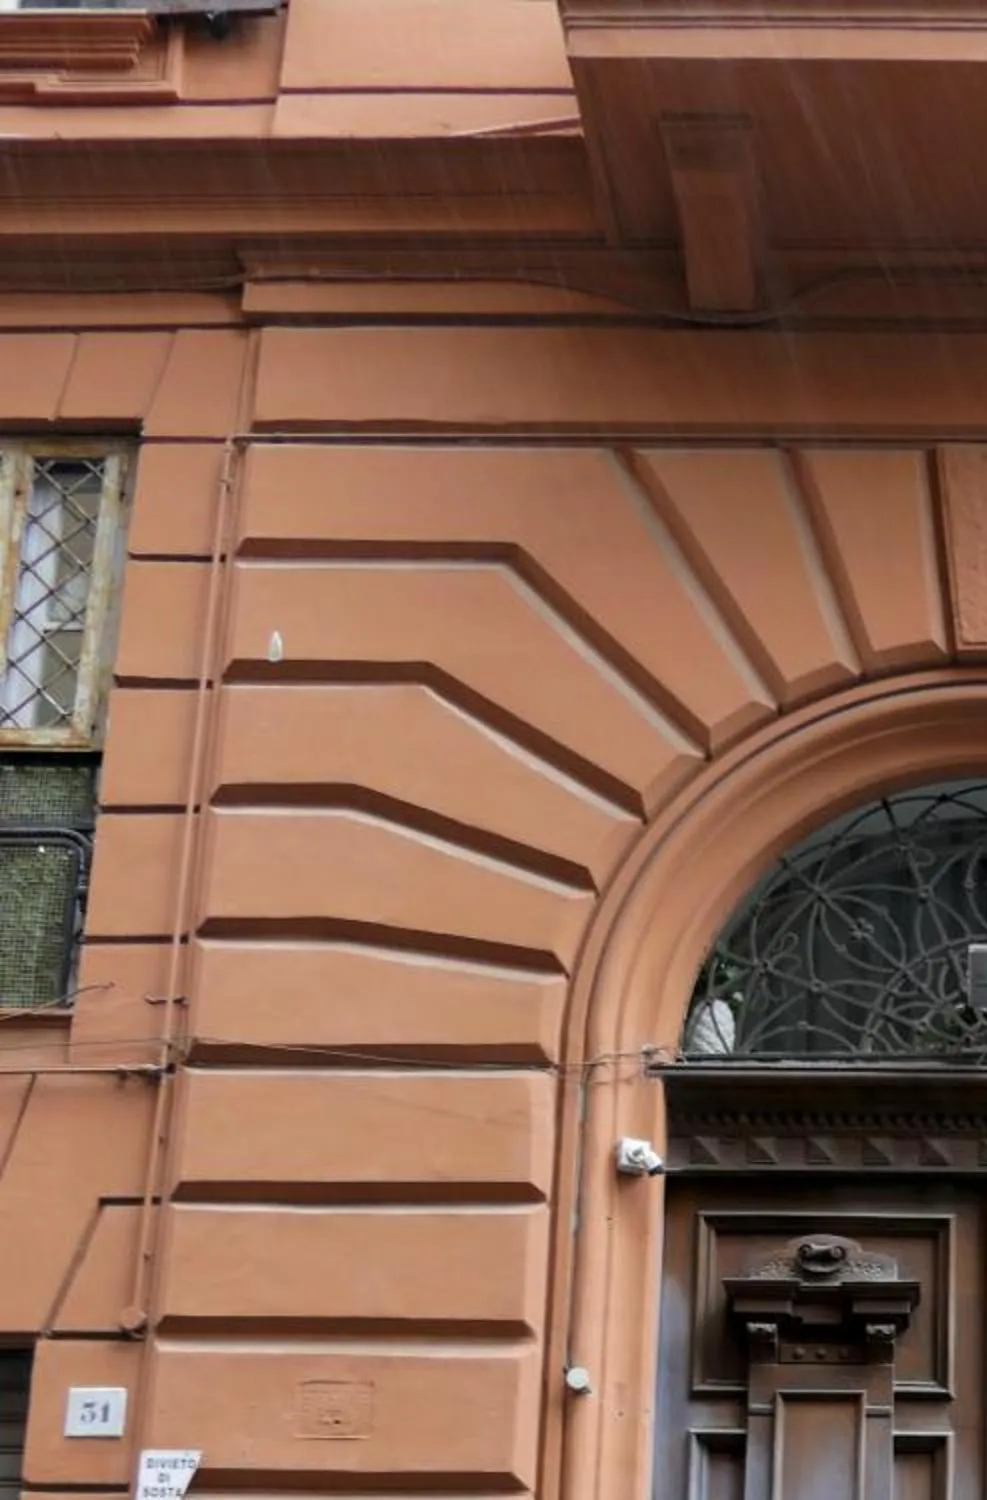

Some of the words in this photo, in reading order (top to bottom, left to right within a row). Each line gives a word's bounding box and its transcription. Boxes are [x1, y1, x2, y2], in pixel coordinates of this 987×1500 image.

[146, 1457, 197, 1470] DIVIETO
[157, 1472, 170, 1483] DI
[143, 1487, 183, 1498] SOSTA
